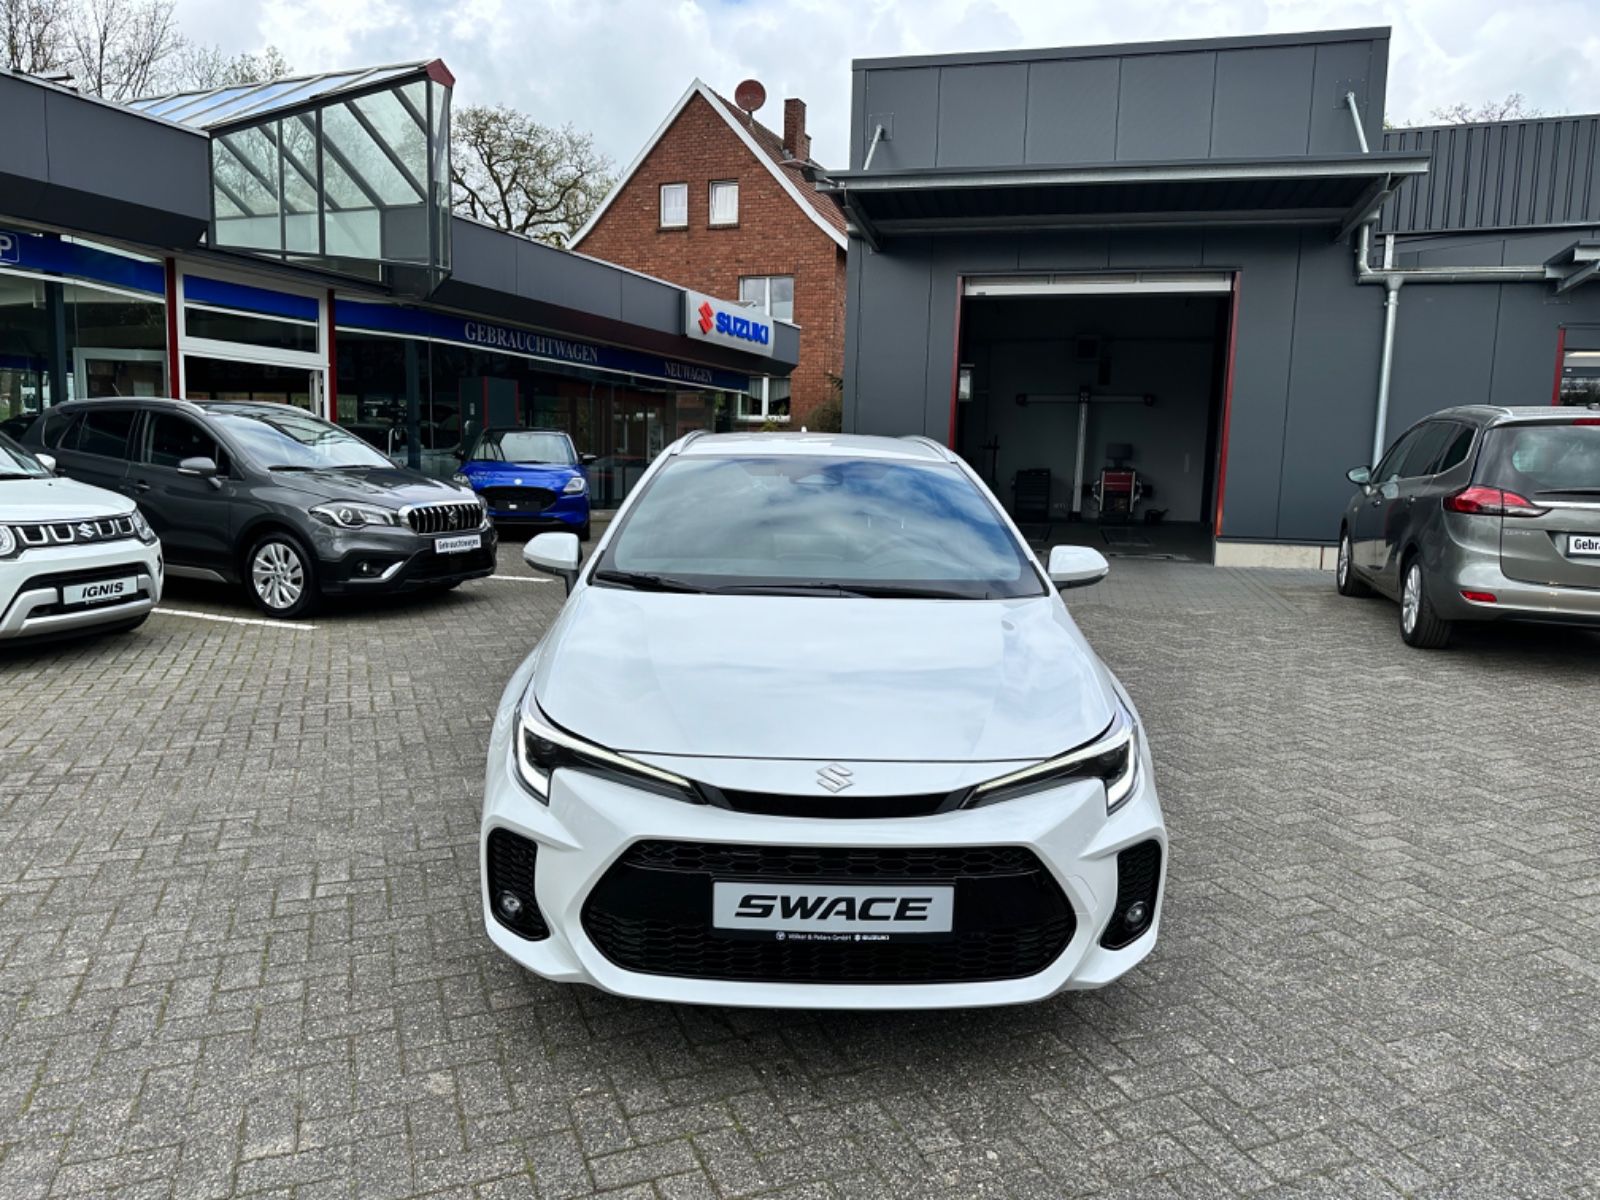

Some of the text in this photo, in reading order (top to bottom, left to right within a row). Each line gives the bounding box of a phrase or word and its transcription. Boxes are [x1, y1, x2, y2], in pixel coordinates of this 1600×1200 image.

[464, 321, 598, 362] GEBRAUCHTWAGEN
[716, 311, 769, 345] SUZUKI
[664, 361, 712, 383] NEUWAGEN
[82, 582, 124, 598] IGNIS
[734, 894, 933, 921] SWACE
